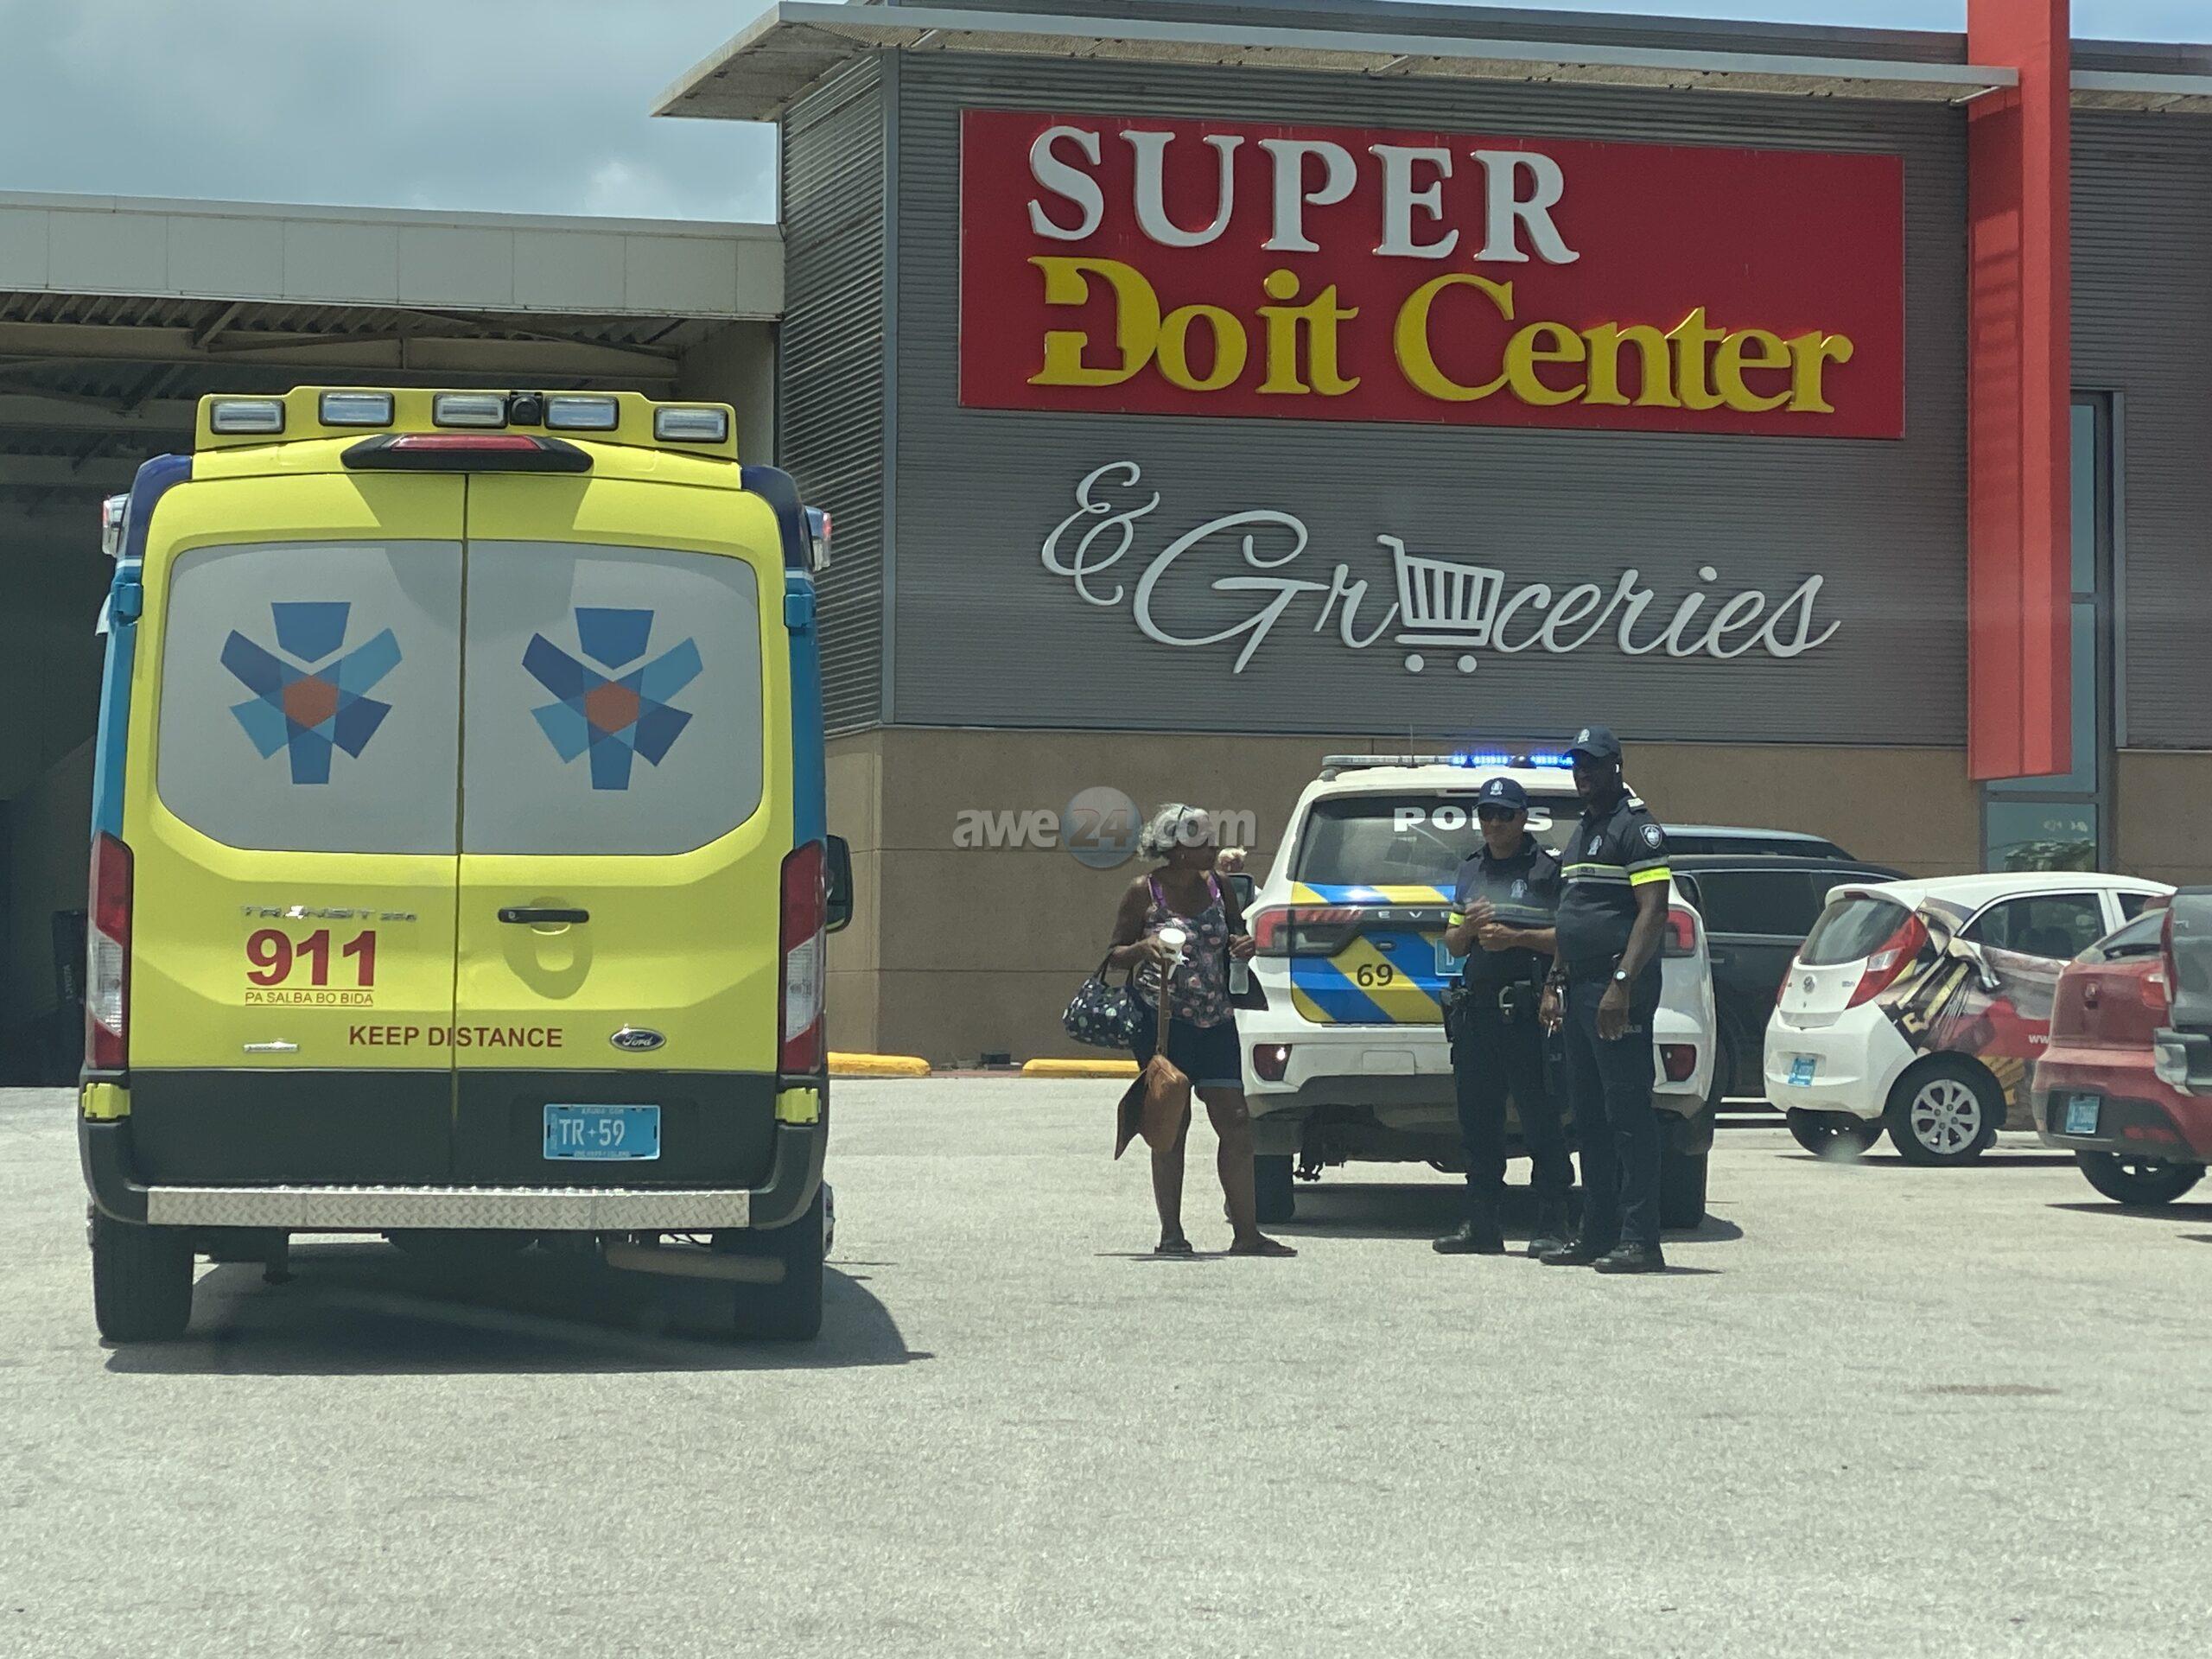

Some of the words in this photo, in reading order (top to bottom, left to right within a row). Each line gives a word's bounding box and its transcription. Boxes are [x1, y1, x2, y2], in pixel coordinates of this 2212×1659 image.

[1028, 125, 1580, 264] SUPER
[1393, 272, 1854, 413] Center
[246, 929, 375, 986] 911
[1357, 963, 1393, 987] 69
[245, 992, 263, 1003] PA
[266, 992, 313, 1003] SALBA
[316, 993, 336, 1003] BO
[340, 993, 373, 1004] BIDA
[349, 1026, 419, 1046] KEEP
[428, 1027, 563, 1047] DISTANCE
